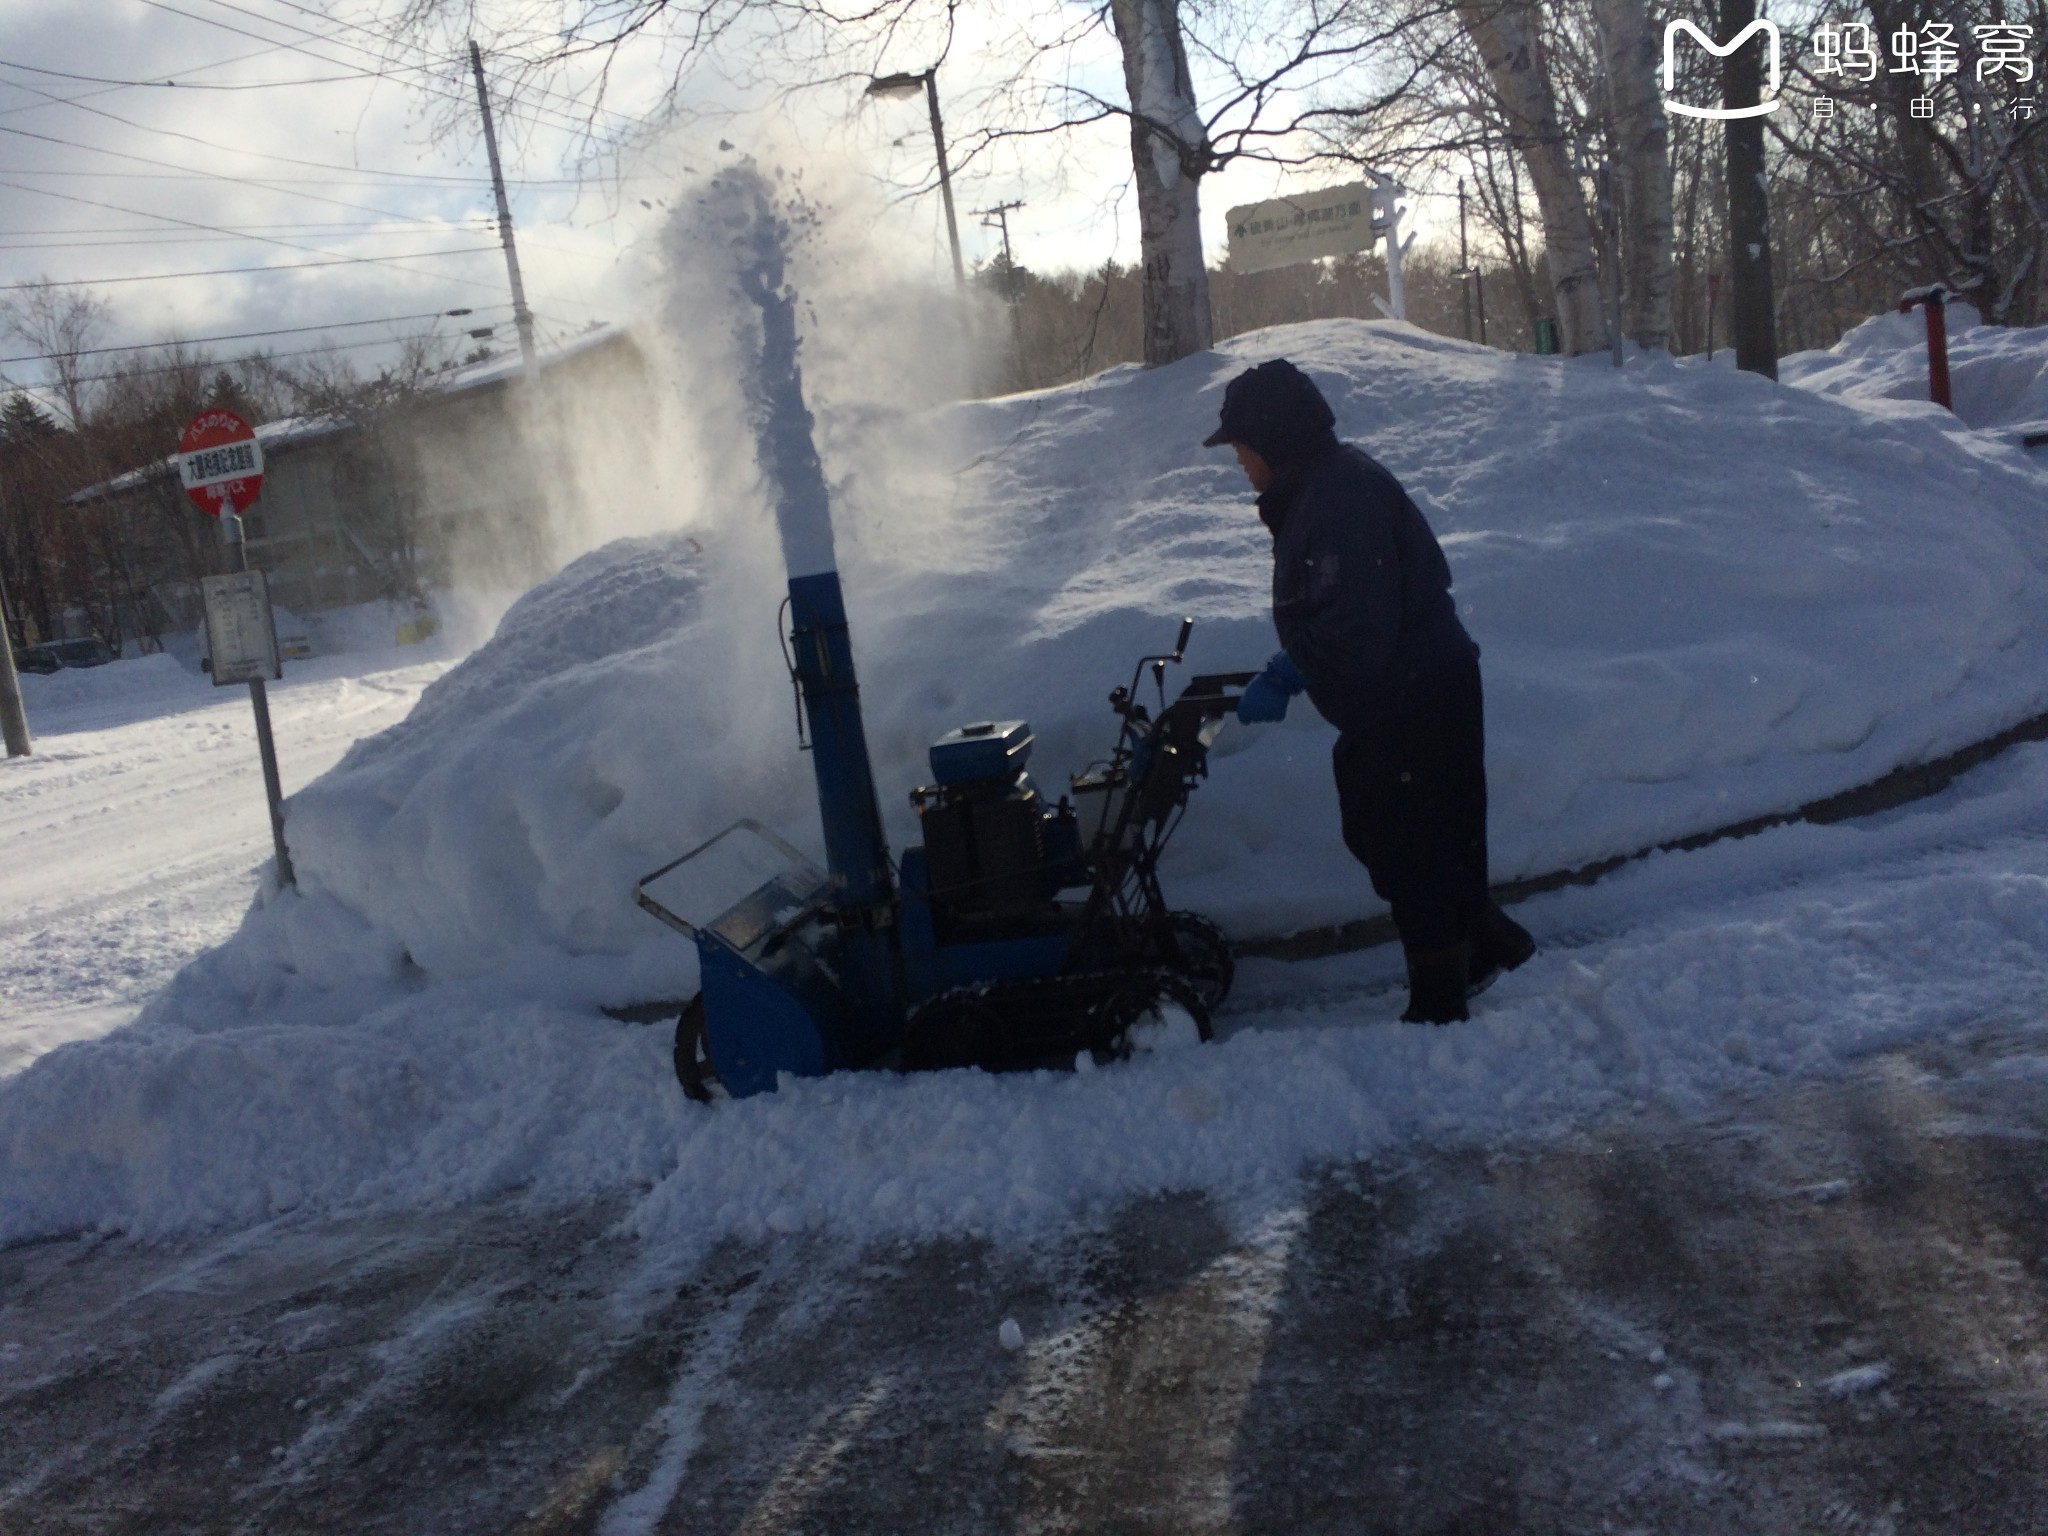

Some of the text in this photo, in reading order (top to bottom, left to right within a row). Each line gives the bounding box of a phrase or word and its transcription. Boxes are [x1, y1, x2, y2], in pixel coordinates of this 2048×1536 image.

[189, 414, 240, 442] バスのりば
